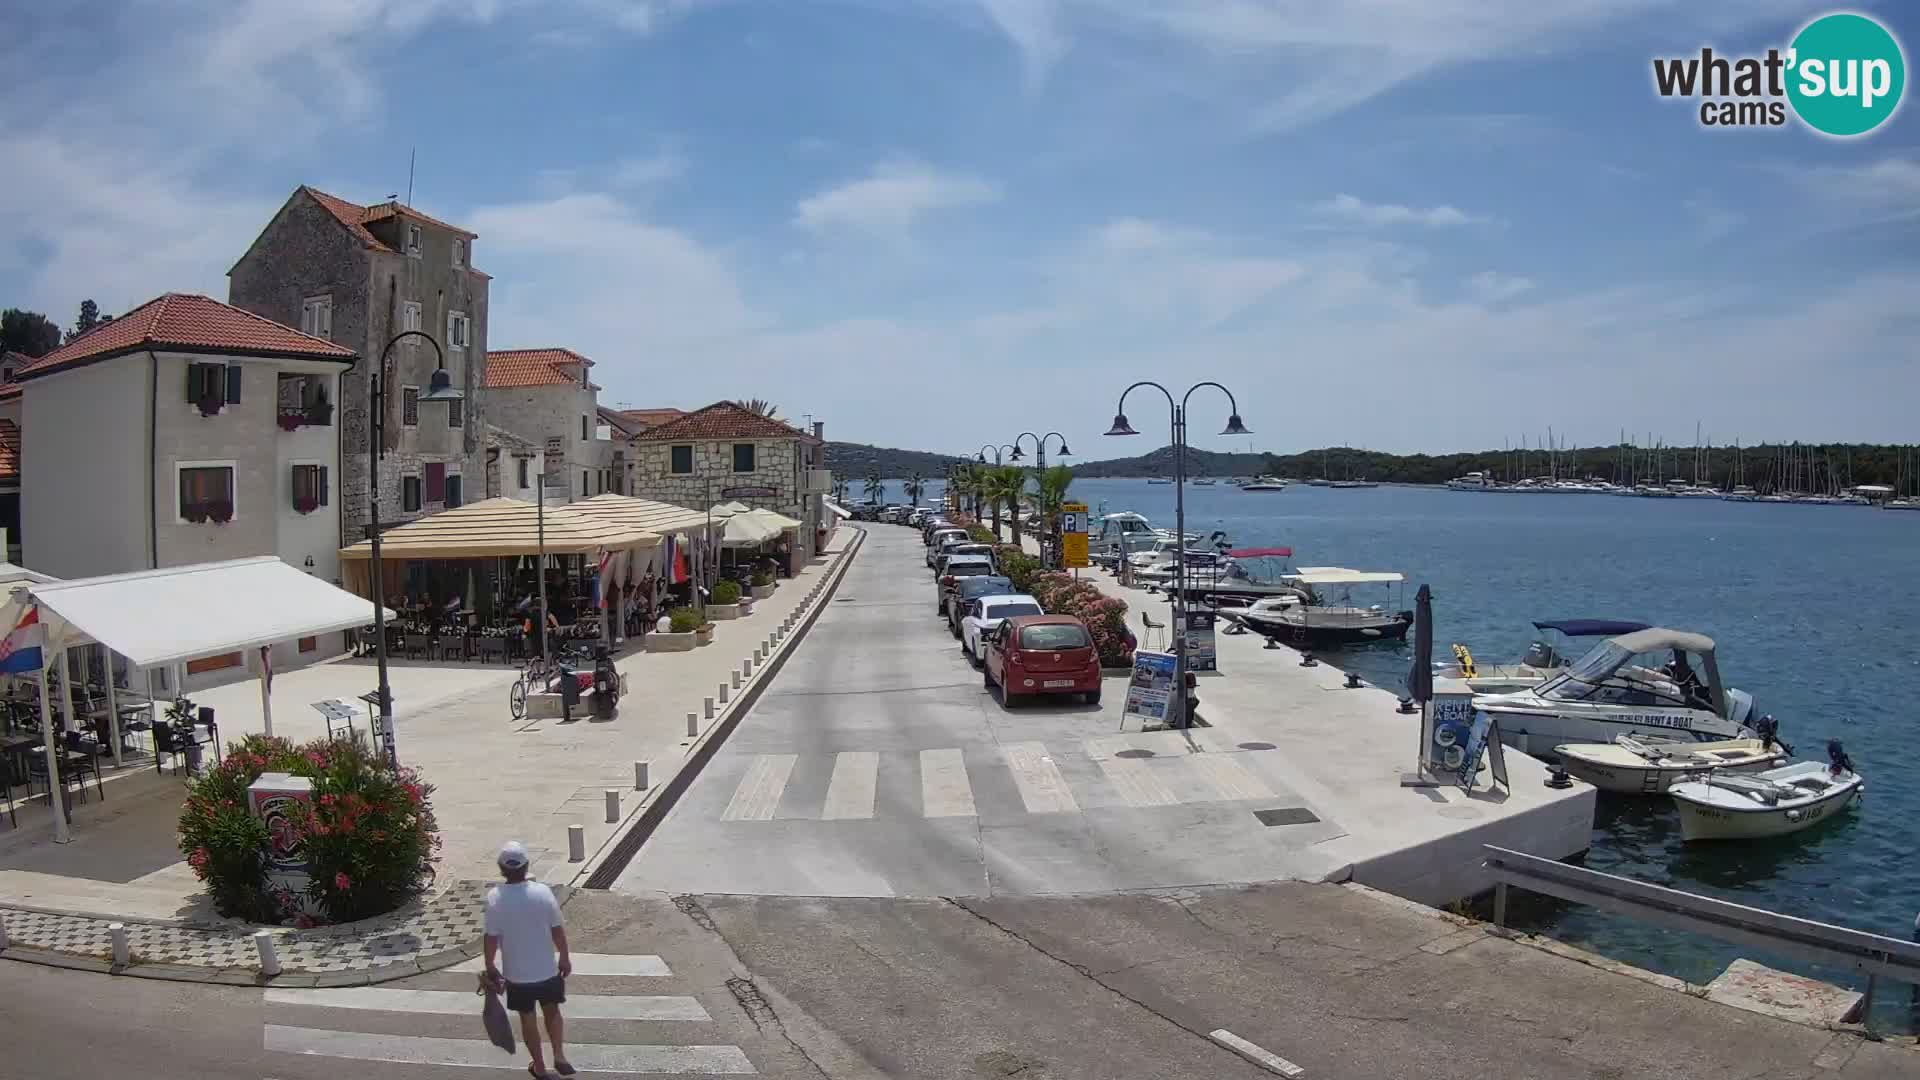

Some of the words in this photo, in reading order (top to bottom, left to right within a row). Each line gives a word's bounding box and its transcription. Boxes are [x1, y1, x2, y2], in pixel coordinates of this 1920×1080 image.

[1064, 514, 1075, 531] P
[1435, 700, 1470, 712] RENT
[1434, 712, 1442, 721] A
[1444, 712, 1469, 721] BOAT
[1644, 714, 1665, 725] RENT
[1666, 716, 1672, 726] A
[1673, 716, 1694, 728] BOAT
